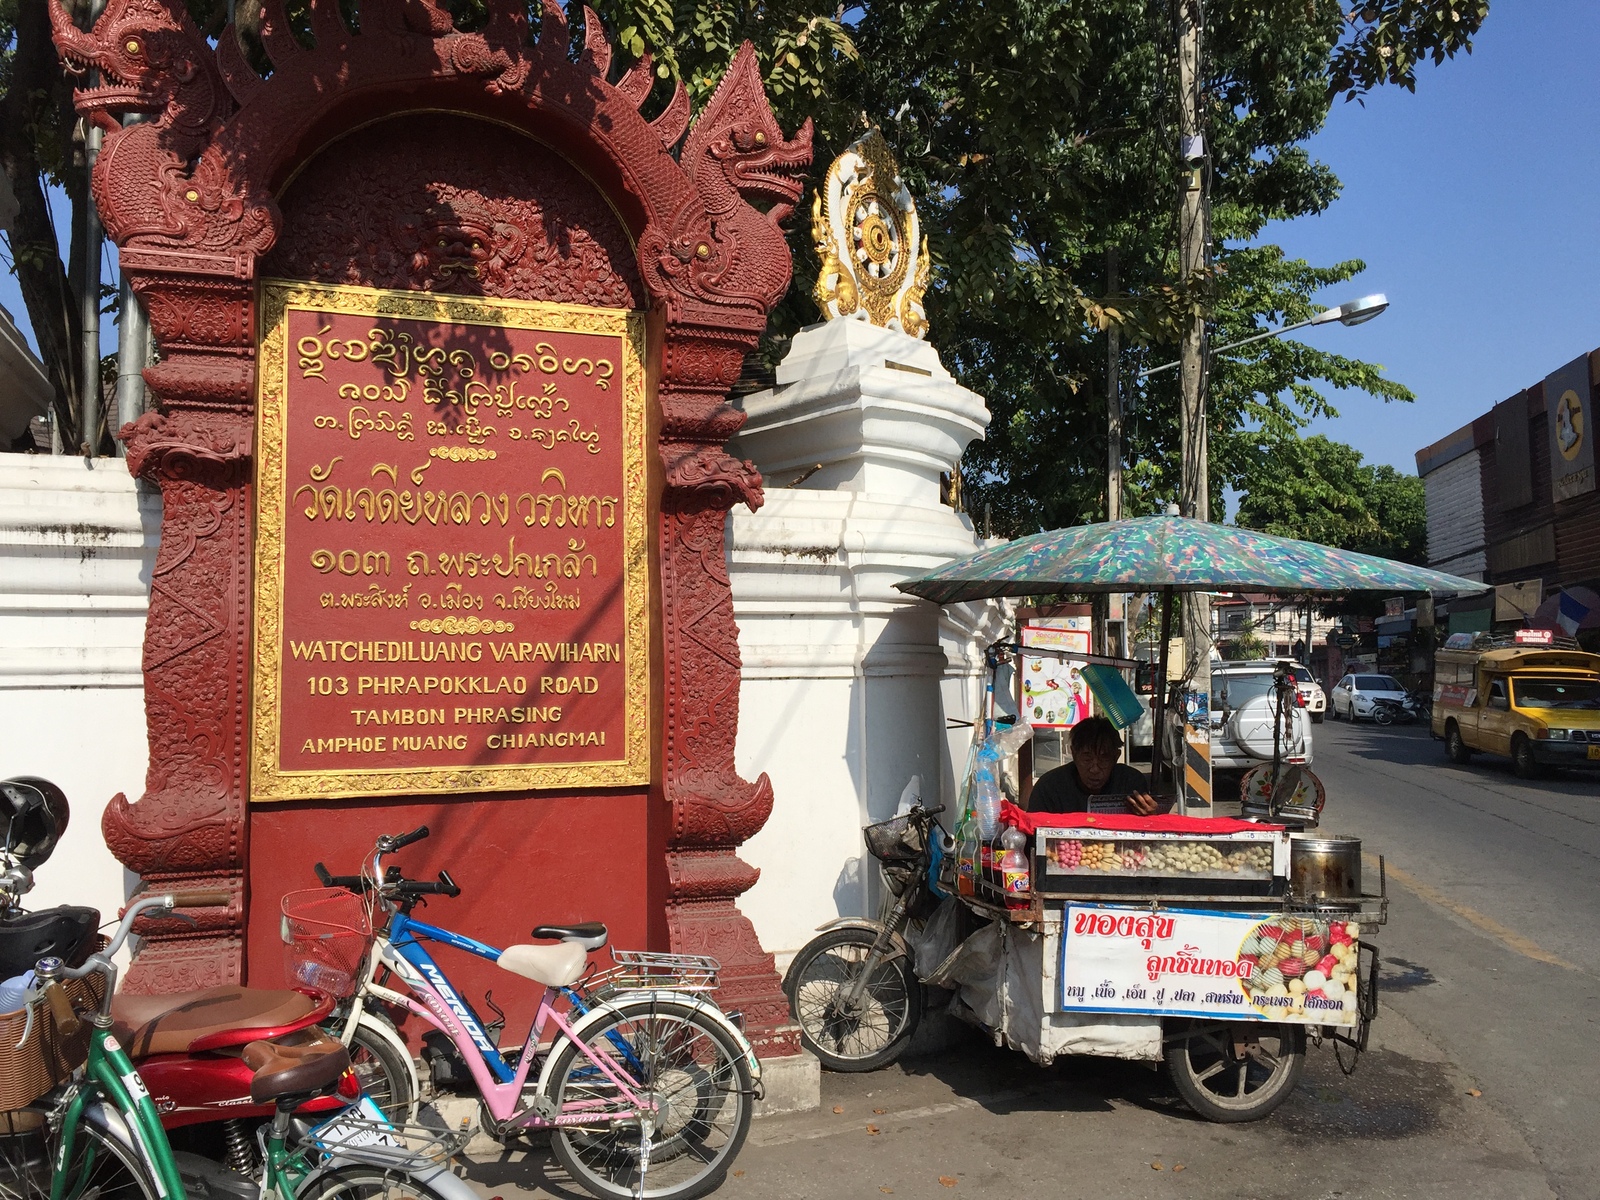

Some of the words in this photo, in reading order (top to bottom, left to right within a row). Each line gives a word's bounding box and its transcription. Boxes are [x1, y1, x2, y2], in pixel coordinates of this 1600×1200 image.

[292, 457, 510, 526] วัดเจดีย์หลวง
[515, 467, 618, 529] วรวิหาร
[310, 547, 391, 575] ๑๐๓
[406, 537, 598, 578] ถ.พระปกเกล้า
[320, 582, 412, 609] ต.พระสิงห์
[418, 583, 484, 610] อ.เมือง
[492, 581, 581, 611] จ.เชียงใหม่
[289, 641, 482, 663] WATCHEDILUANG
[488, 642, 621, 664] VARAVIHARN
[307, 676, 349, 695] 103
[357, 676, 527, 695] PHRAPOKKLAO
[540, 676, 599, 694] ROAD
[351, 709, 445, 725] TAMBON
[454, 706, 562, 725] PHRASING
[301, 737, 386, 753] AMPHOE
[392, 735, 468, 752] MUANG
[486, 731, 606, 750] CHIANGMAI
[1074, 912, 1176, 950] ทองสุข
[1146, 944, 1255, 982] ลูกชิ้นทอด
[420, 964, 494, 1051] MERIDA
[56, 1144, 66, 1172] LA
